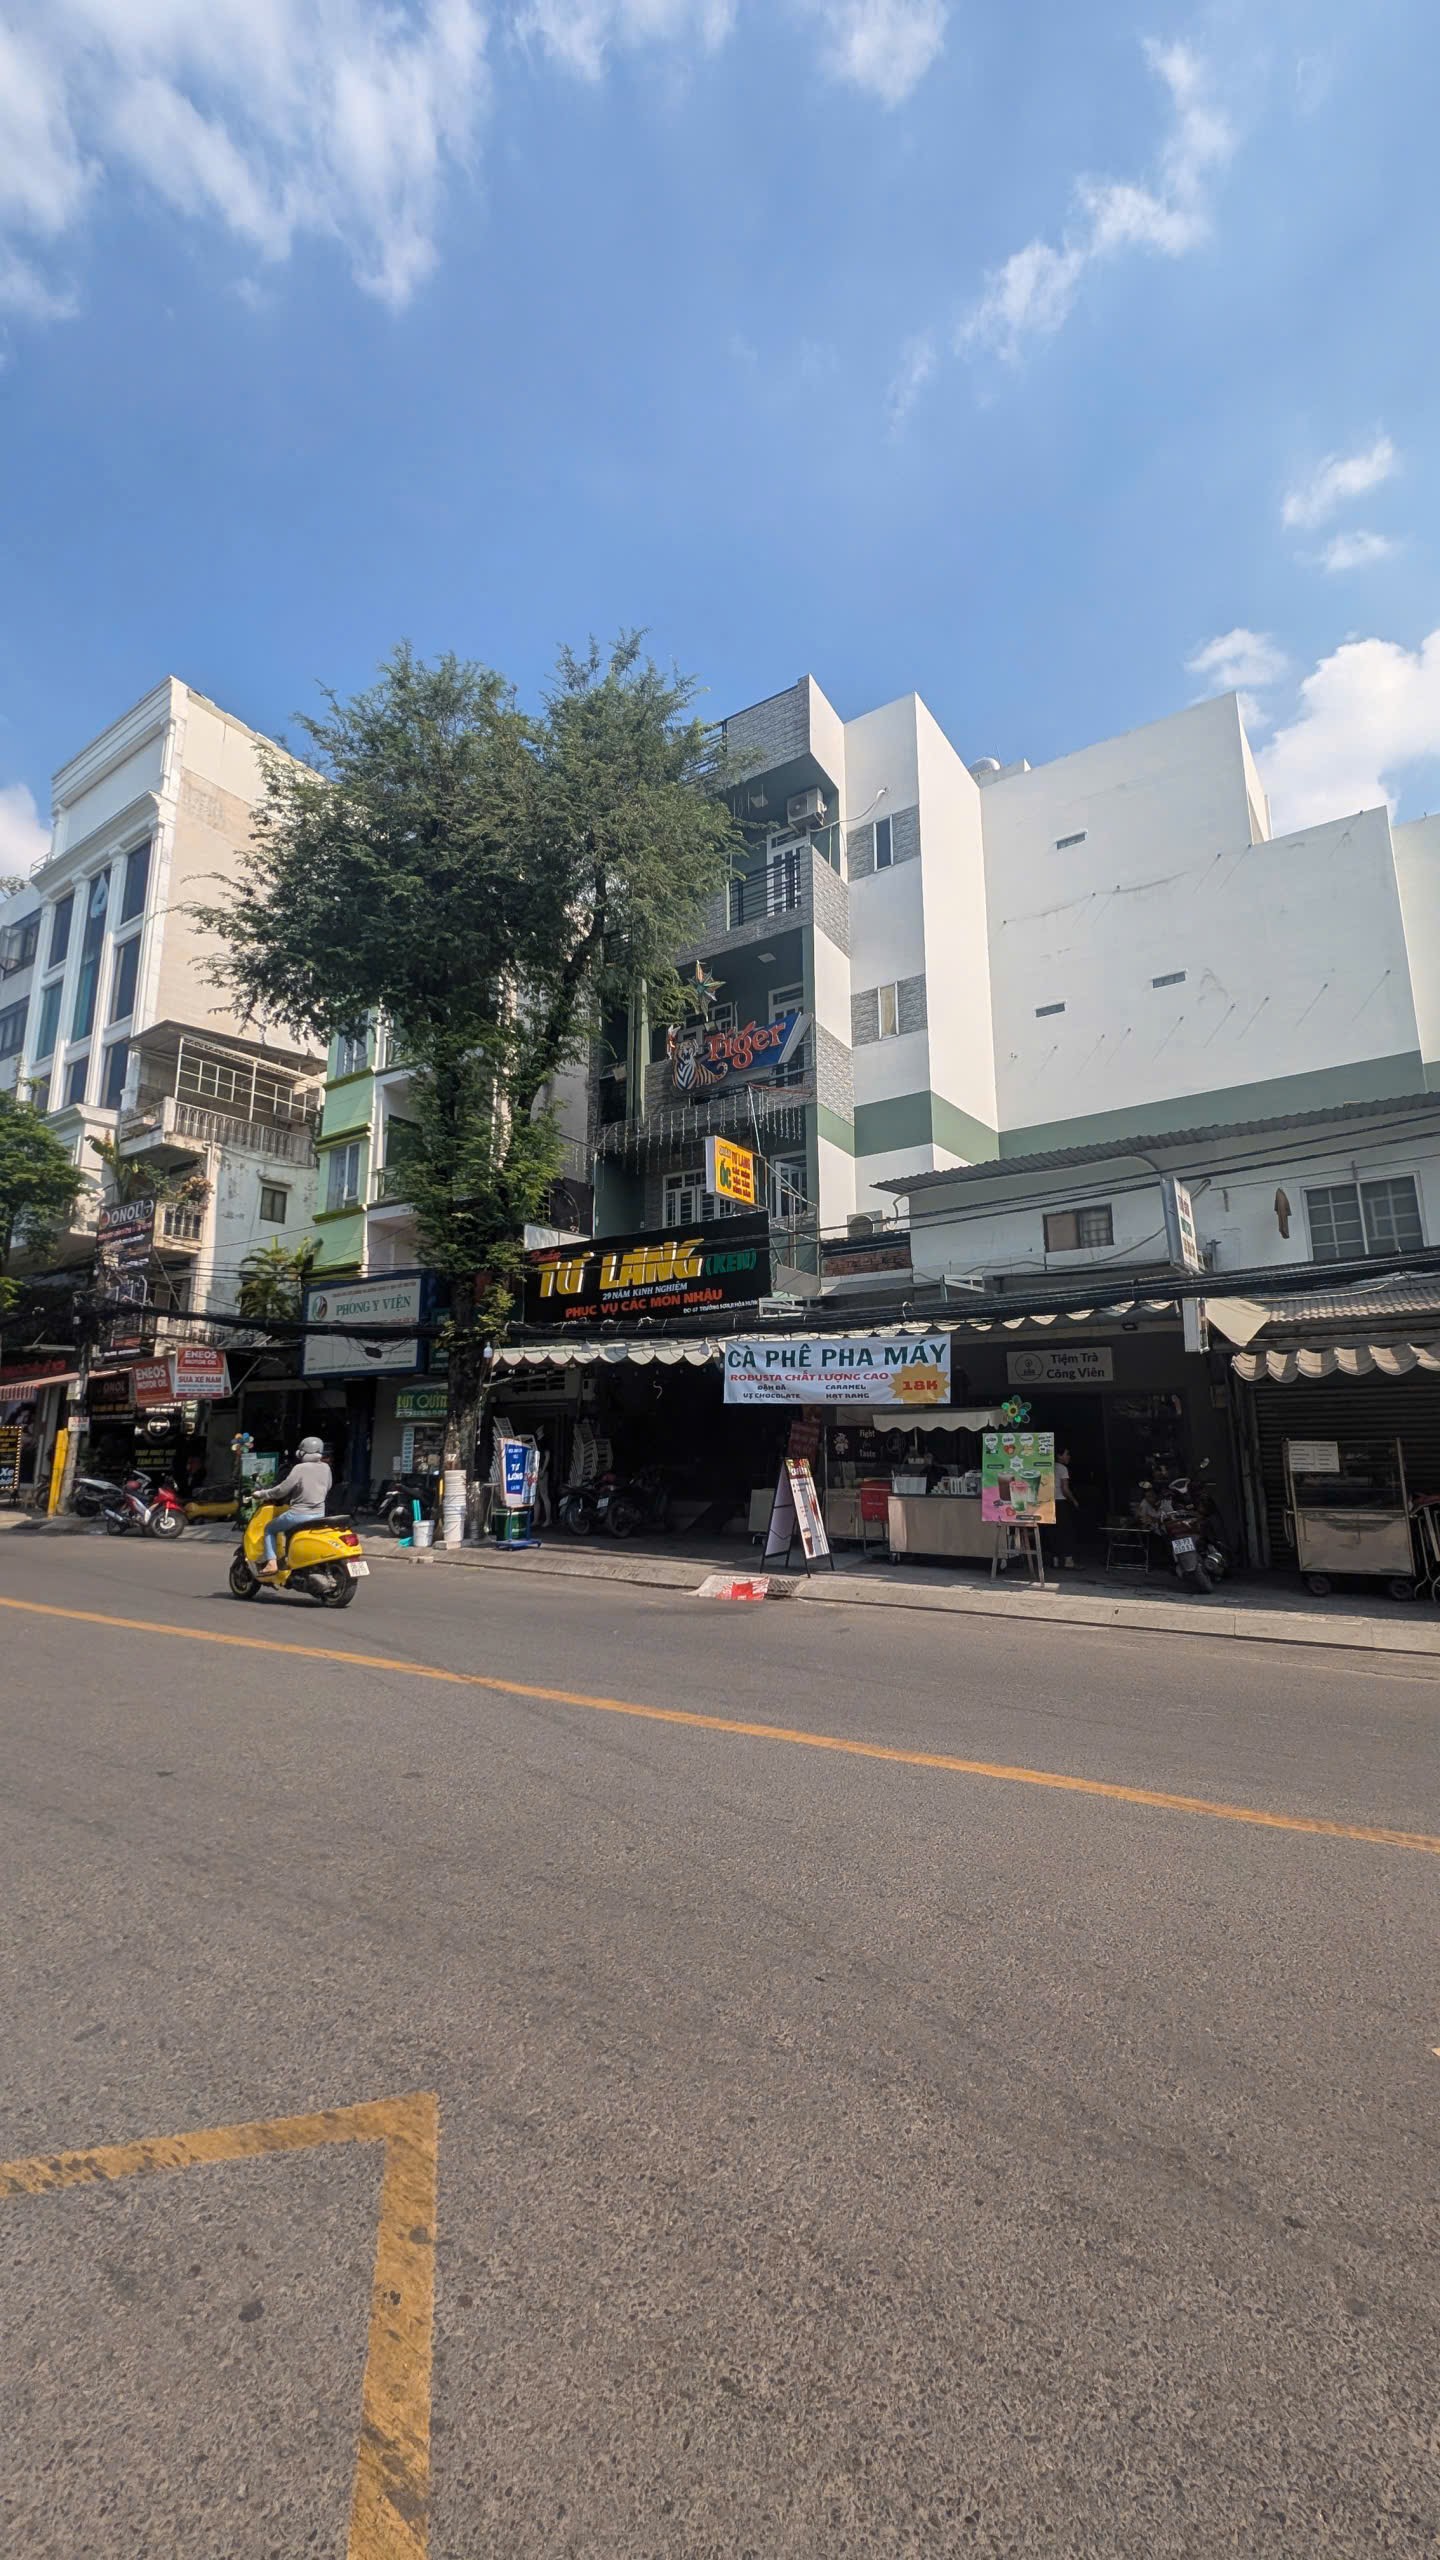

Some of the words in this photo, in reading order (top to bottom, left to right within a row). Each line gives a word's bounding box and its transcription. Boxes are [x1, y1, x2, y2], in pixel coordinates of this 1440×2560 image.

[704, 1020, 786, 1069] Tiger
[538, 1251, 595, 1297] TƯ
[602, 1291, 611, 1301] 29
[612, 1288, 630, 1300] NĂM
[633, 1286, 653, 1297] KINH
[656, 1281, 688, 1294] NGHIỆM
[683, 1287, 723, 1304] NHẬU
[371, 1299, 380, 1311] Y
[382, 1294, 411, 1312] VIỆN
[184, 1350, 218, 1359] ENEOS
[728, 1345, 756, 1368] CÀ
[765, 1343, 812, 1367] PHÊ
[821, 1348, 874, 1367] PHA
[884, 1339, 947, 1366] MÁY
[1050, 1353, 1078, 1366] Tiệm
[1080, 1352, 1098, 1363] Trà
[135, 1365, 167, 1380] ENEOS
[195, 1375, 204, 1383] XE
[730, 1373, 782, 1382] ROBUSTA
[785, 1369, 814, 1381] CHẤT
[818, 1372, 861, 1382] LƯỢNG
[863, 1372, 889, 1381] CAO
[1046, 1368, 1076, 1380] Công
[1078, 1367, 1105, 1378] Viên
[902, 1380, 938, 1391] 18K
